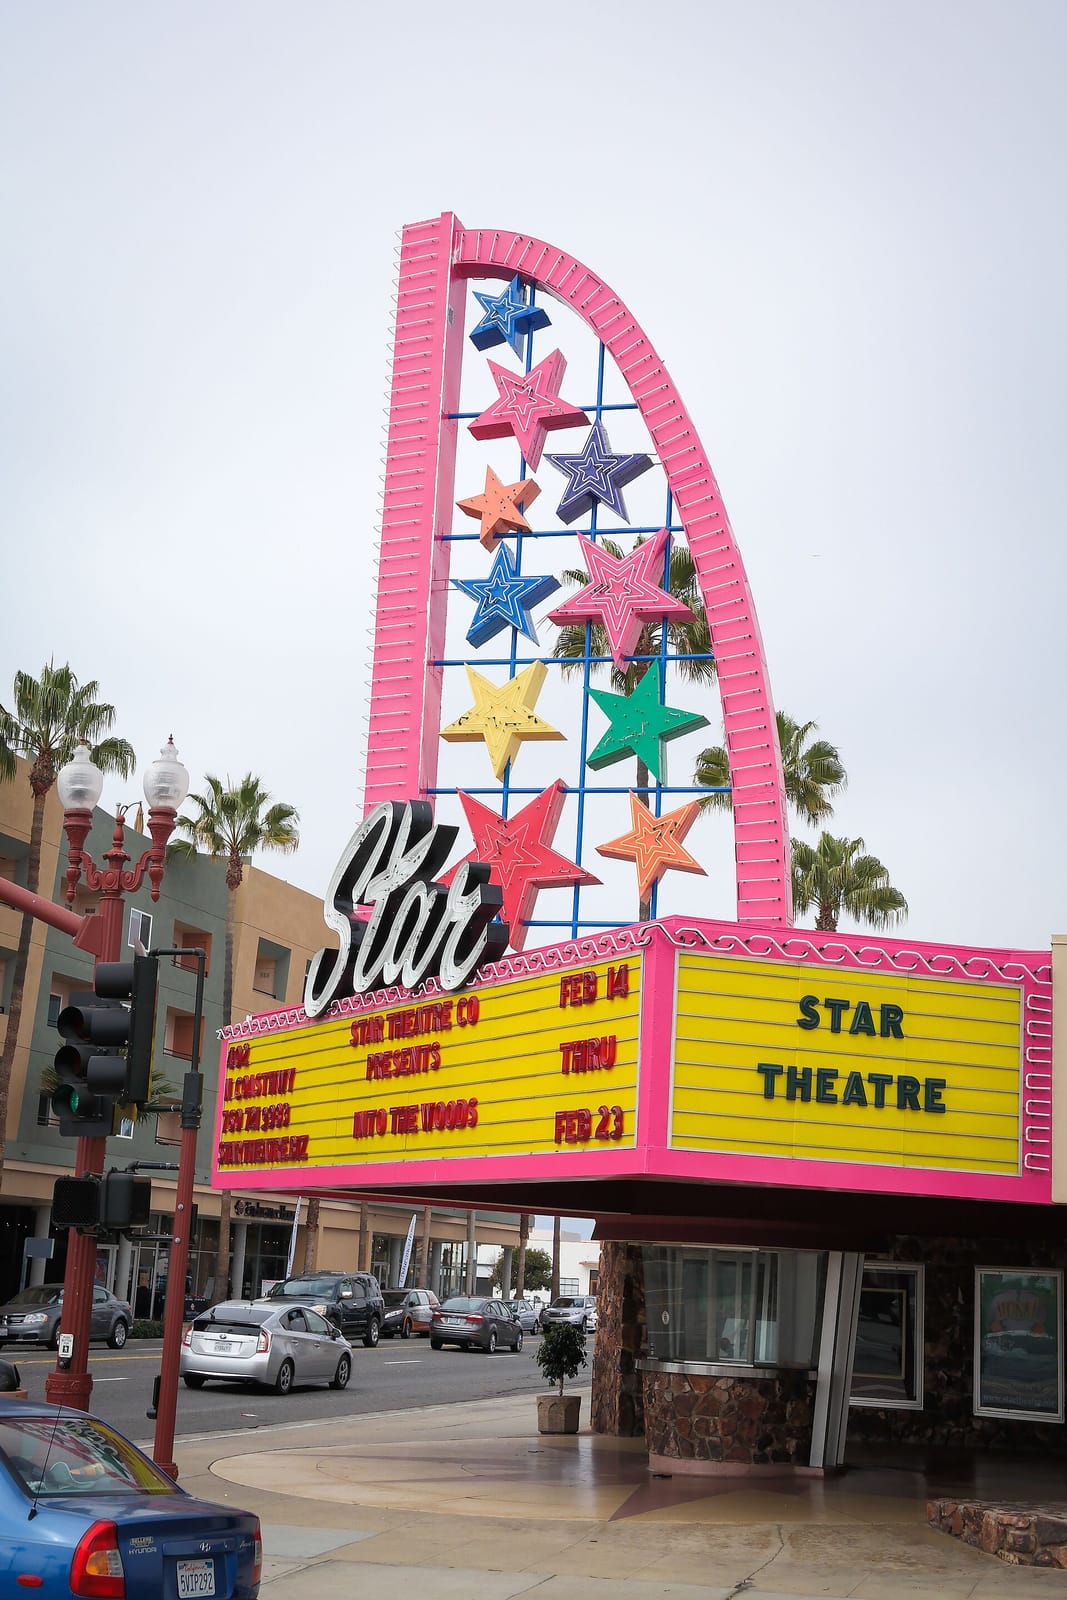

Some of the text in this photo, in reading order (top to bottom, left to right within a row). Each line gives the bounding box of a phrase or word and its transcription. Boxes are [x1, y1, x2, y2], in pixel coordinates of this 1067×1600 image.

[304, 799, 509, 1018] Star
[559, 964, 630, 1008] FEB 14
[350, 996, 480, 1048] STAR THEATRE CO
[796, 995, 905, 1039] STAR
[366, 1041, 442, 1081] PRESENTS
[560, 1035, 617, 1075] THRU
[757, 1062, 947, 1113] THEATRE
[353, 1097, 479, 1139] INTO THE WOODS
[554, 1105, 625, 1144] FEB 23
[180, 1572, 214, 1592] 5VIP292
